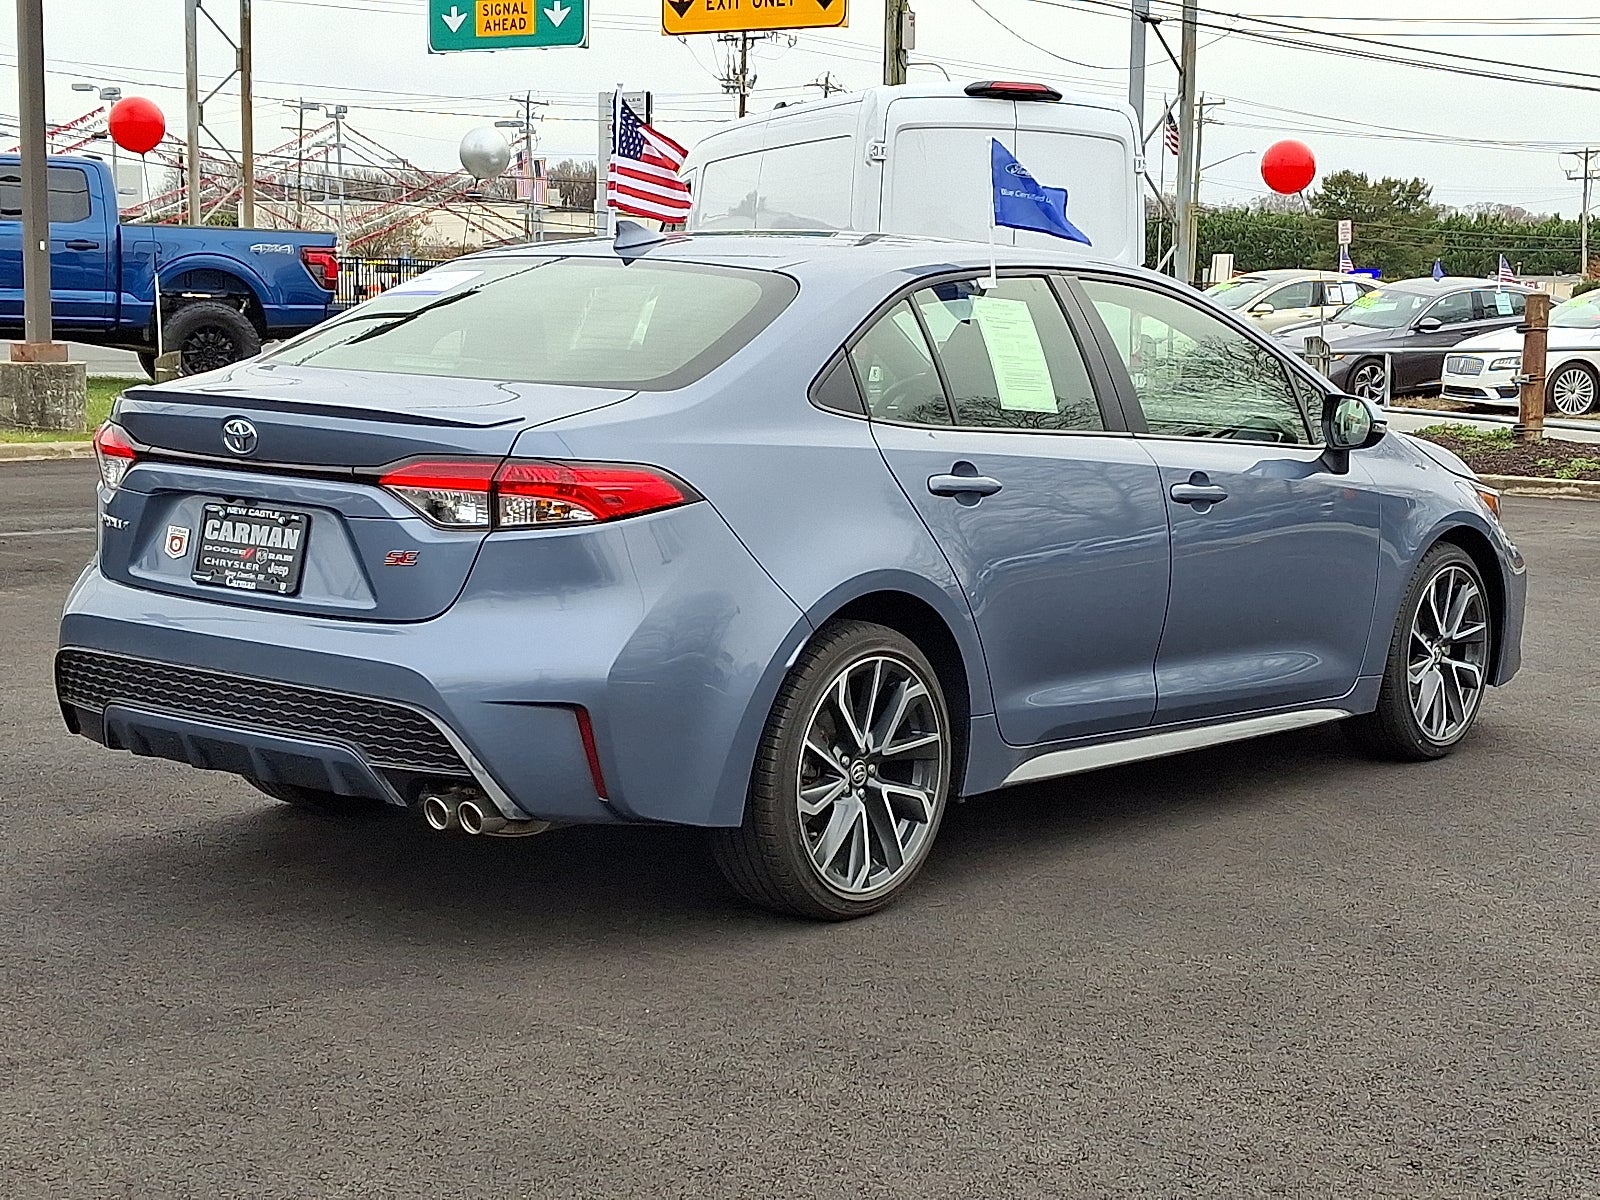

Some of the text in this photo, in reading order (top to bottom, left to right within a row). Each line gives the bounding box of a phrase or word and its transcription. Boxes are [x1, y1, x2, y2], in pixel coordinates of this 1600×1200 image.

[482, 2, 528, 16] SIGNAL
[484, 17, 527, 32] AHEAD
[226, 506, 247, 516] NEW
[248, 508, 281, 520] CASTLE
[205, 519, 300, 550] CARMAN
[203, 545, 246, 556] DODGE
[268, 553, 294, 562] RAM
[203, 557, 260, 571] CHRYSLER
[384, 550, 420, 566] SE
[268, 562, 289, 577] Jeep
